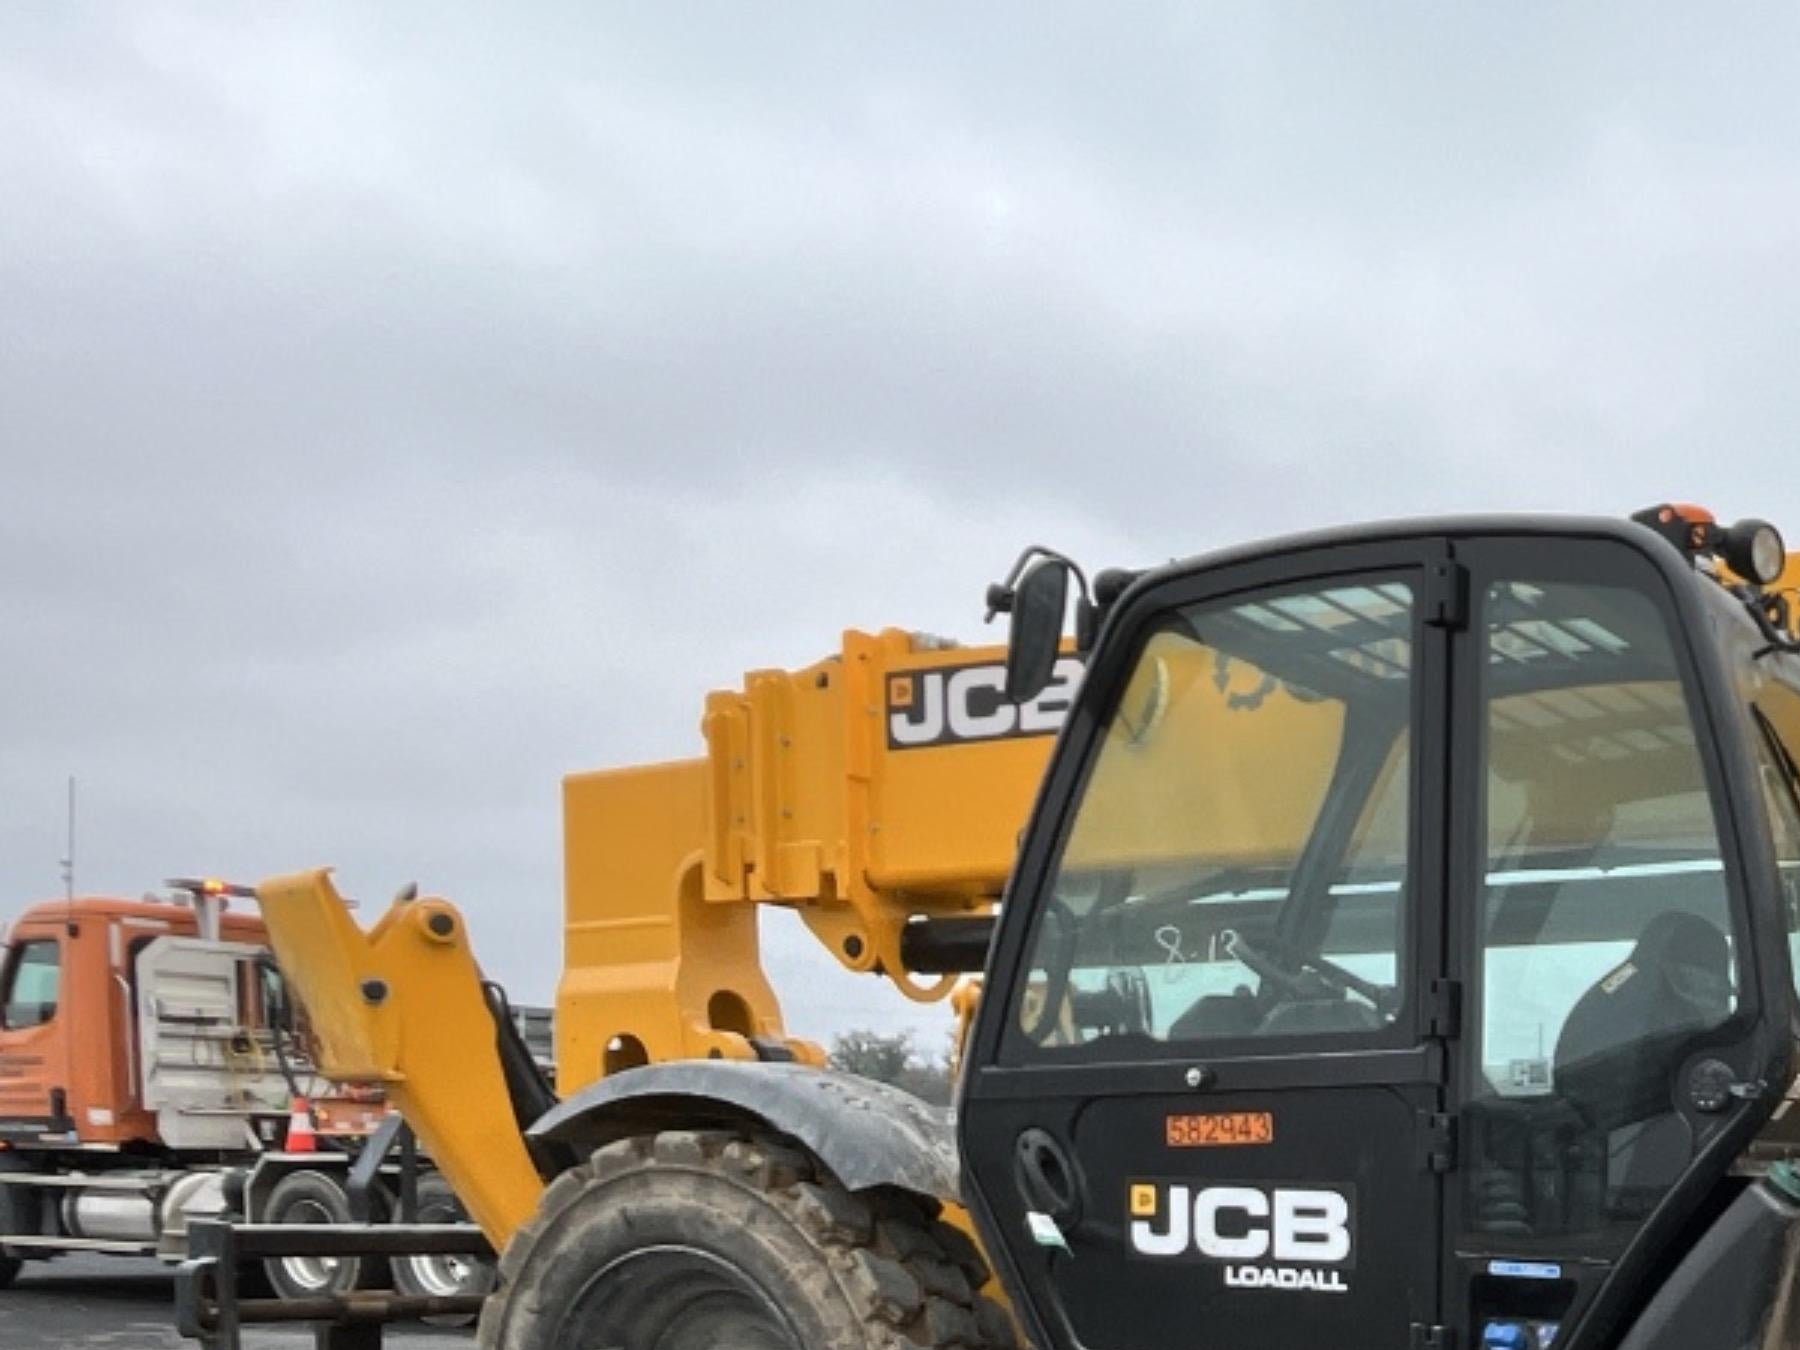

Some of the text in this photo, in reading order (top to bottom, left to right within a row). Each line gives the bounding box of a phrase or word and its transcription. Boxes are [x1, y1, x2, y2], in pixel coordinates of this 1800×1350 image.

[1170, 1113, 1271, 1144] 582943
[1131, 1184, 1350, 1261] JCB
[1224, 1265, 1349, 1291] LOADALL
